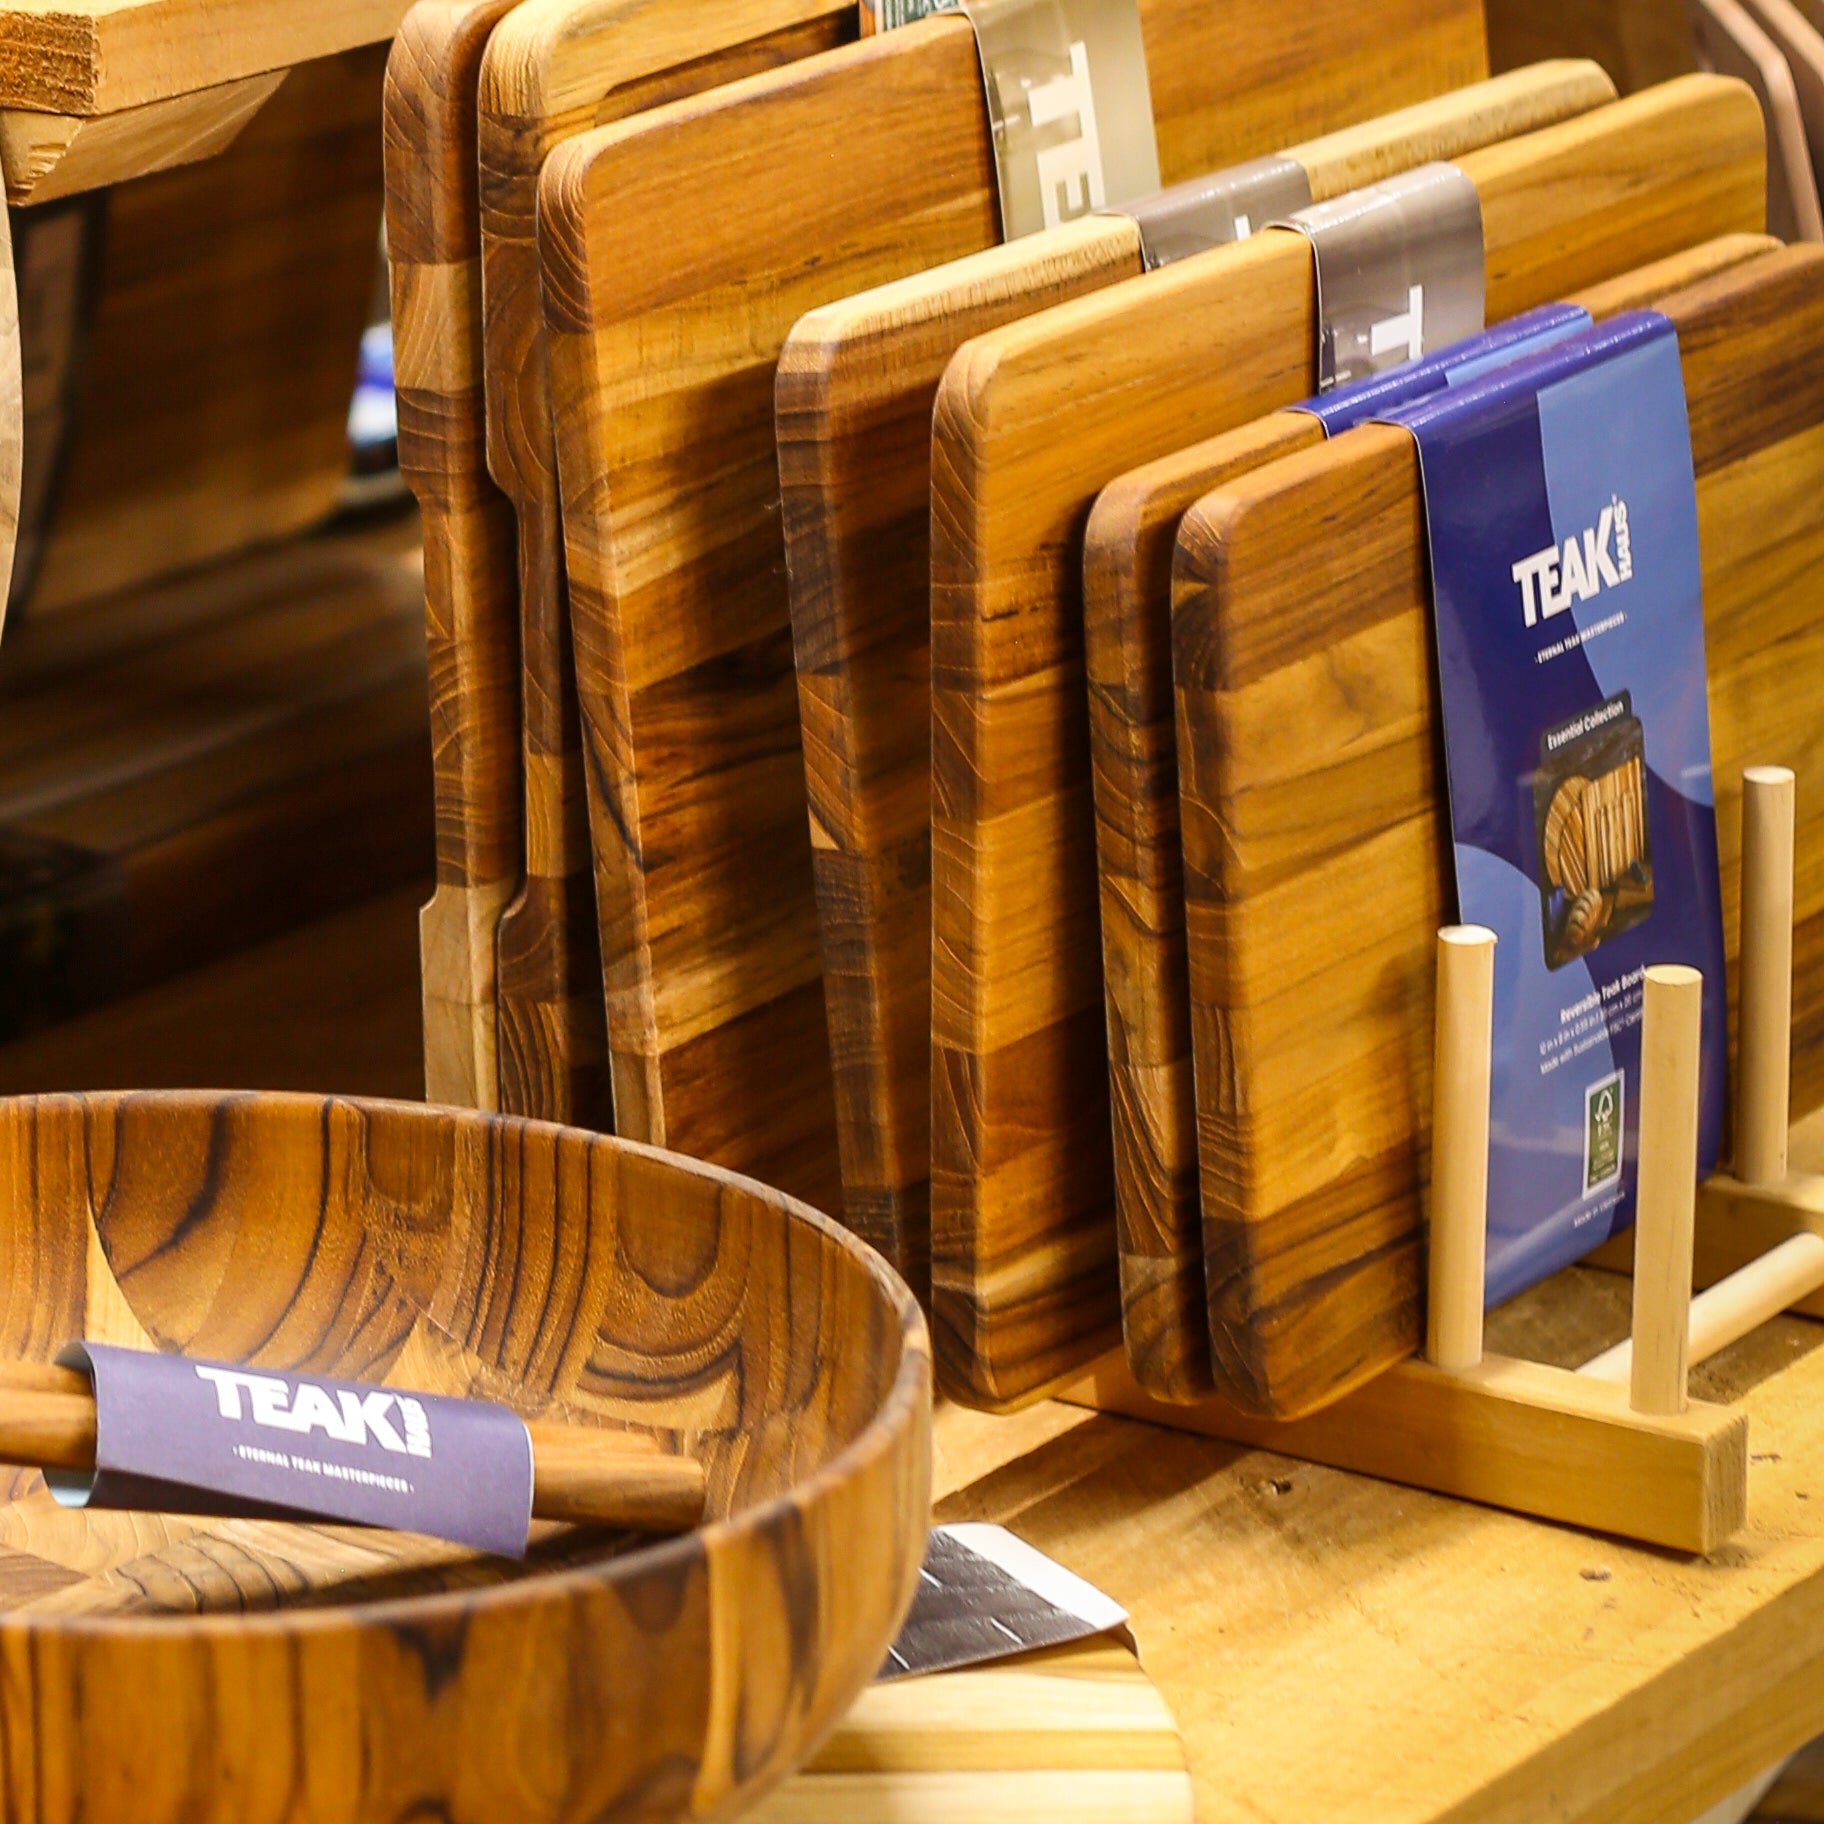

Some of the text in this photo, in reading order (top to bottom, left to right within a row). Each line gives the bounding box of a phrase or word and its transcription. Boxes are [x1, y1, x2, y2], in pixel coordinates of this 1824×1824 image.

[1511, 504, 1621, 628] TEAK
[1547, 700, 1624, 751] Essential Collection
[194, 1364, 408, 1455] TEAK
[237, 1443, 410, 1494] ETERNAL TEAK MASTERPIECES
